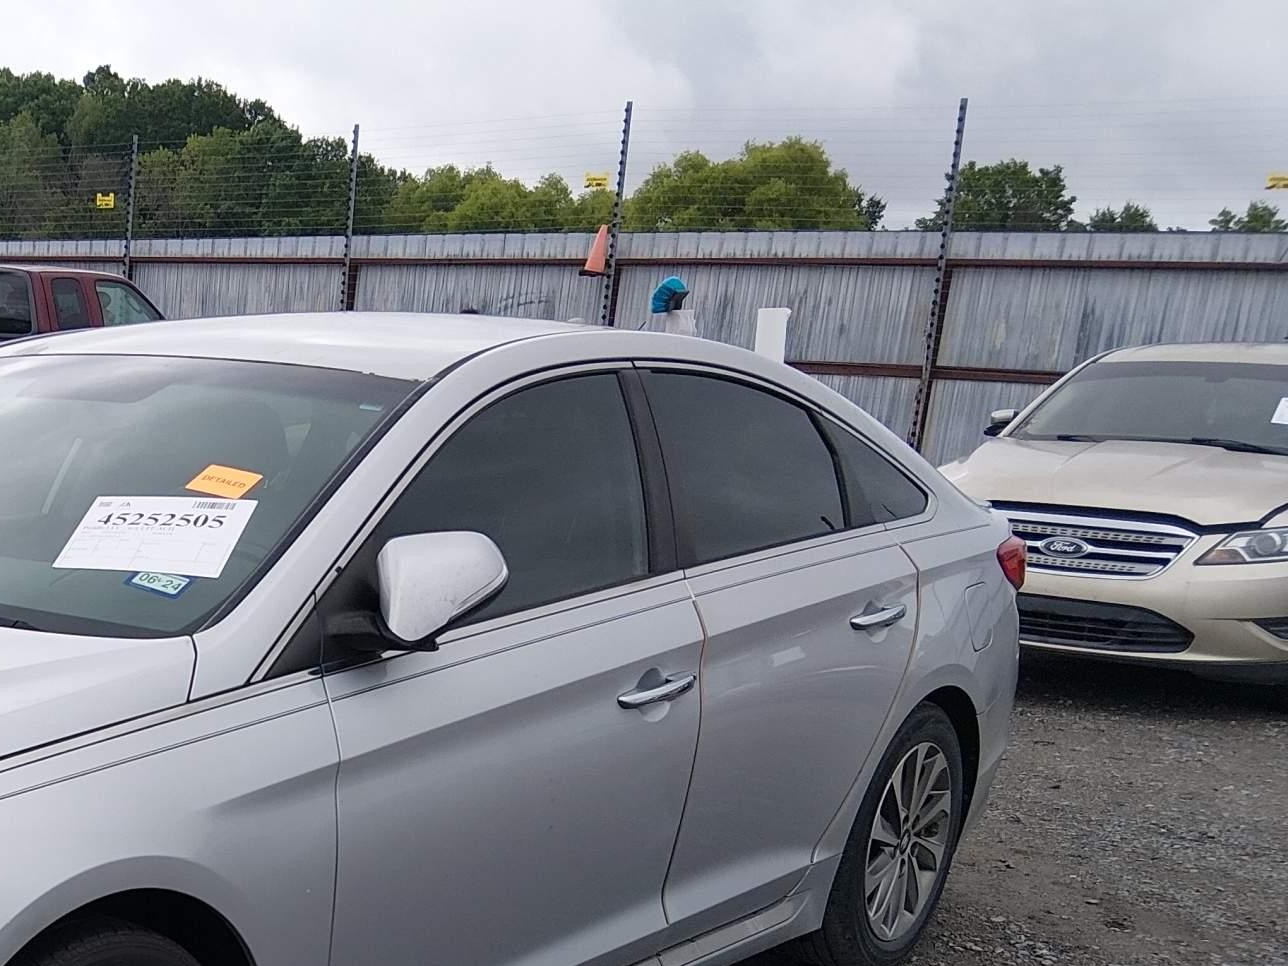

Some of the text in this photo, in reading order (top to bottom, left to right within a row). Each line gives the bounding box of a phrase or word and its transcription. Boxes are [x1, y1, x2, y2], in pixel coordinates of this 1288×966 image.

[202, 474, 246, 488] DETAILED
[97, 513, 227, 528] 45252505
[1050, 541, 1077, 551] Ford
[139, 573, 183, 590] 06 24
